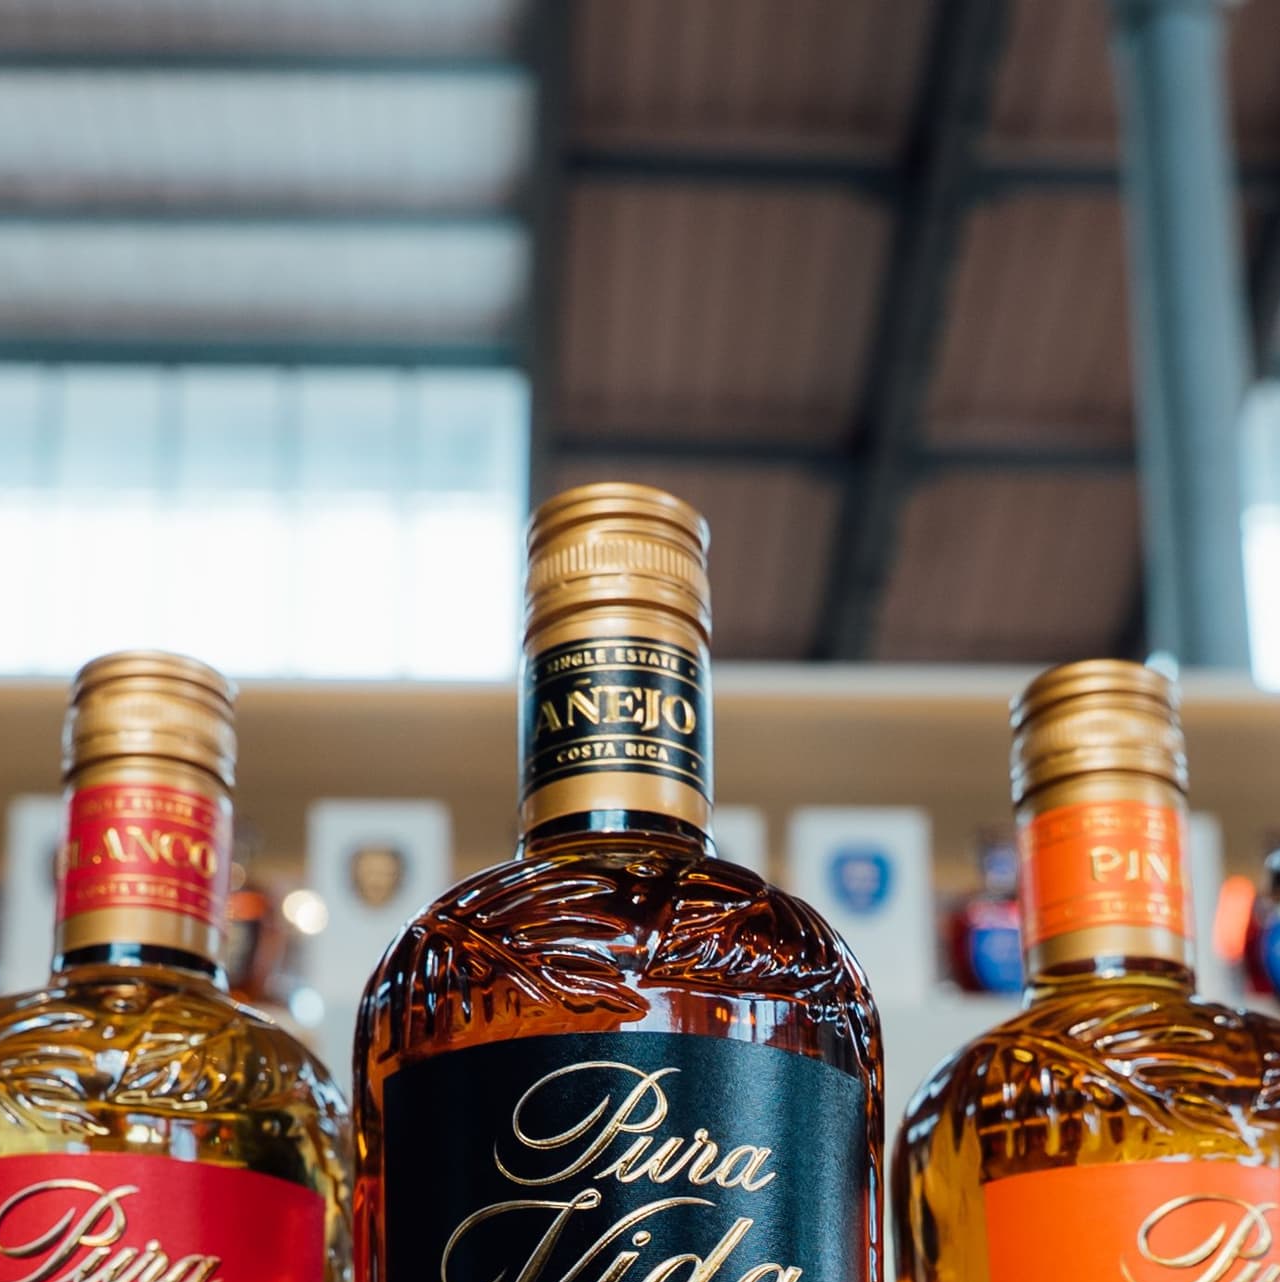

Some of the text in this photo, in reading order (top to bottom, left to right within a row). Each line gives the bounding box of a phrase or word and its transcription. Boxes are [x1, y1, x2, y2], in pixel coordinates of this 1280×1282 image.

[547, 648, 680, 674] SINGLE ESTATE
[536, 678, 697, 739] AÑEJO
[556, 742, 669, 764] COSTA RICA
[493, 1060, 777, 1192] Pura
